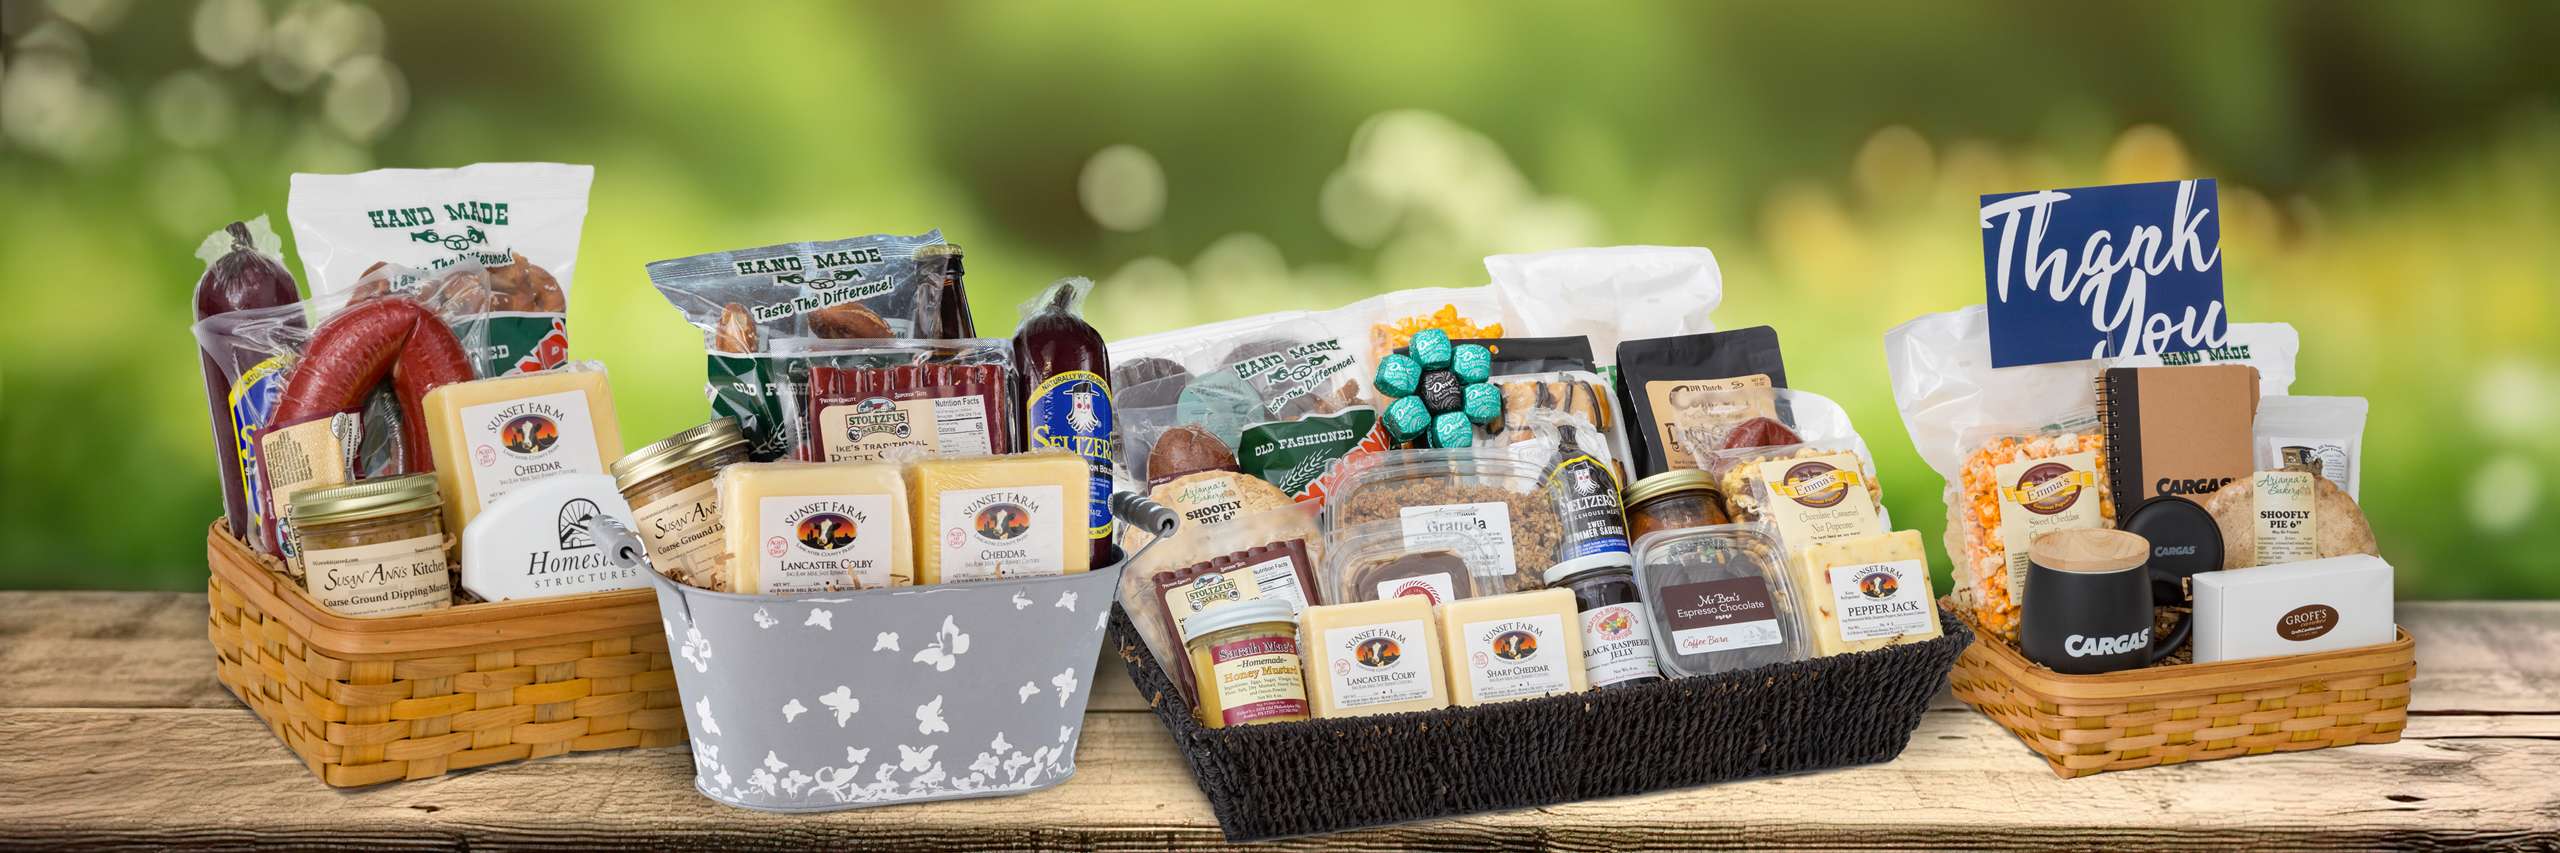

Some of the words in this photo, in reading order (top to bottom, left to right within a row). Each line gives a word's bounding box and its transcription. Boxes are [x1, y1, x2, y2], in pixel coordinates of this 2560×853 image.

[368, 206, 435, 228] HAND
[444, 201, 509, 226] MADE
[1980, 179, 2220, 303] Thank
[737, 256, 802, 274] HAND
[813, 249, 882, 269] MADE
[755, 303, 793, 320] Taste
[795, 297, 819, 311] The
[823, 277, 893, 305] Difference!
[2080, 267, 2230, 359] You
[1235, 353, 1284, 379] HAND
[1289, 339, 1341, 359] MADE
[2159, 351, 2202, 365] HAND
[2210, 345, 2250, 361] MADE
[1288, 388, 1304, 400] The
[1306, 355, 1357, 391] Difference!
[733, 382, 757, 396] OLD
[935, 398, 961, 407] Nutrition
[962, 397, 980, 406] Facts
[488, 404, 525, 433] SUNSET
[529, 402, 565, 421] FARM
[848, 412, 906, 425] STOLTZFUS
[863, 425, 895, 435] MEATS
[836, 444, 860, 452] IKE'S
[1255, 442, 1274, 456] OLD
[1279, 429, 1354, 450] FASHIONED
[514, 461, 563, 477] CHEDDAR
[1795, 474, 1836, 496] Emma's
[2027, 476, 2070, 501] Emma's
[2156, 478, 2232, 496] CARGAS
[2257, 474, 2308, 487] Arianna's
[785, 502, 828, 526] SUNSET
[832, 502, 867, 523] FARM
[963, 492, 1004, 518] SUNSET
[1007, 492, 1039, 513] FARM
[1185, 501, 1242, 520] SHOOFLY
[2260, 511, 2310, 519] SHOOFLY
[655, 518, 690, 539] SUSAN
[658, 541, 680, 555] Coarse
[681, 526, 714, 545] Ground
[981, 549, 1027, 560] CHEDDAR
[2155, 546, 2195, 557] CARGAS
[324, 568, 369, 590] SUSAN
[413, 559, 445, 577] Kitchen
[781, 560, 838, 571] LANCASTER
[840, 559, 874, 570] COLBY
[1852, 565, 1878, 584] SUNSET
[1880, 565, 1903, 580] FARM
[535, 568, 640, 589] STRUCTURES
[323, 598, 349, 608] Coarse
[351, 592, 388, 604] Ground
[392, 587, 429, 600] Dipping
[1189, 581, 1234, 600] STOLTZFUS
[1698, 595, 1715, 607] Mr
[1714, 592, 1740, 604] Ben's
[1677, 607, 1717, 619] Espresso
[1719, 601, 1765, 612] Chocolate
[1848, 603, 1889, 617] PEPPER
[1891, 600, 1919, 613] JACK
[2286, 608, 2327, 625] GROFF'S
[1345, 629, 1377, 651] SUNSET
[1379, 628, 1406, 644] FARM
[1482, 622, 1514, 644] SUNSET
[1516, 621, 1543, 637] FARM
[1683, 638, 1706, 649] Coffee
[1709, 635, 1728, 644] Barn
[1219, 642, 1261, 660] Sarah
[1263, 640, 1294, 653] Mae's
[2064, 628, 2149, 658] CARGAS
[1610, 648, 1633, 660] JELLY
[1224, 668, 1261, 683] Honey
[1346, 674, 1389, 686] LANCASTER
[1391, 671, 1417, 681] COLBY
[1487, 668, 1511, 679] SHARP
[1513, 664, 1550, 676] CHEDDAR
